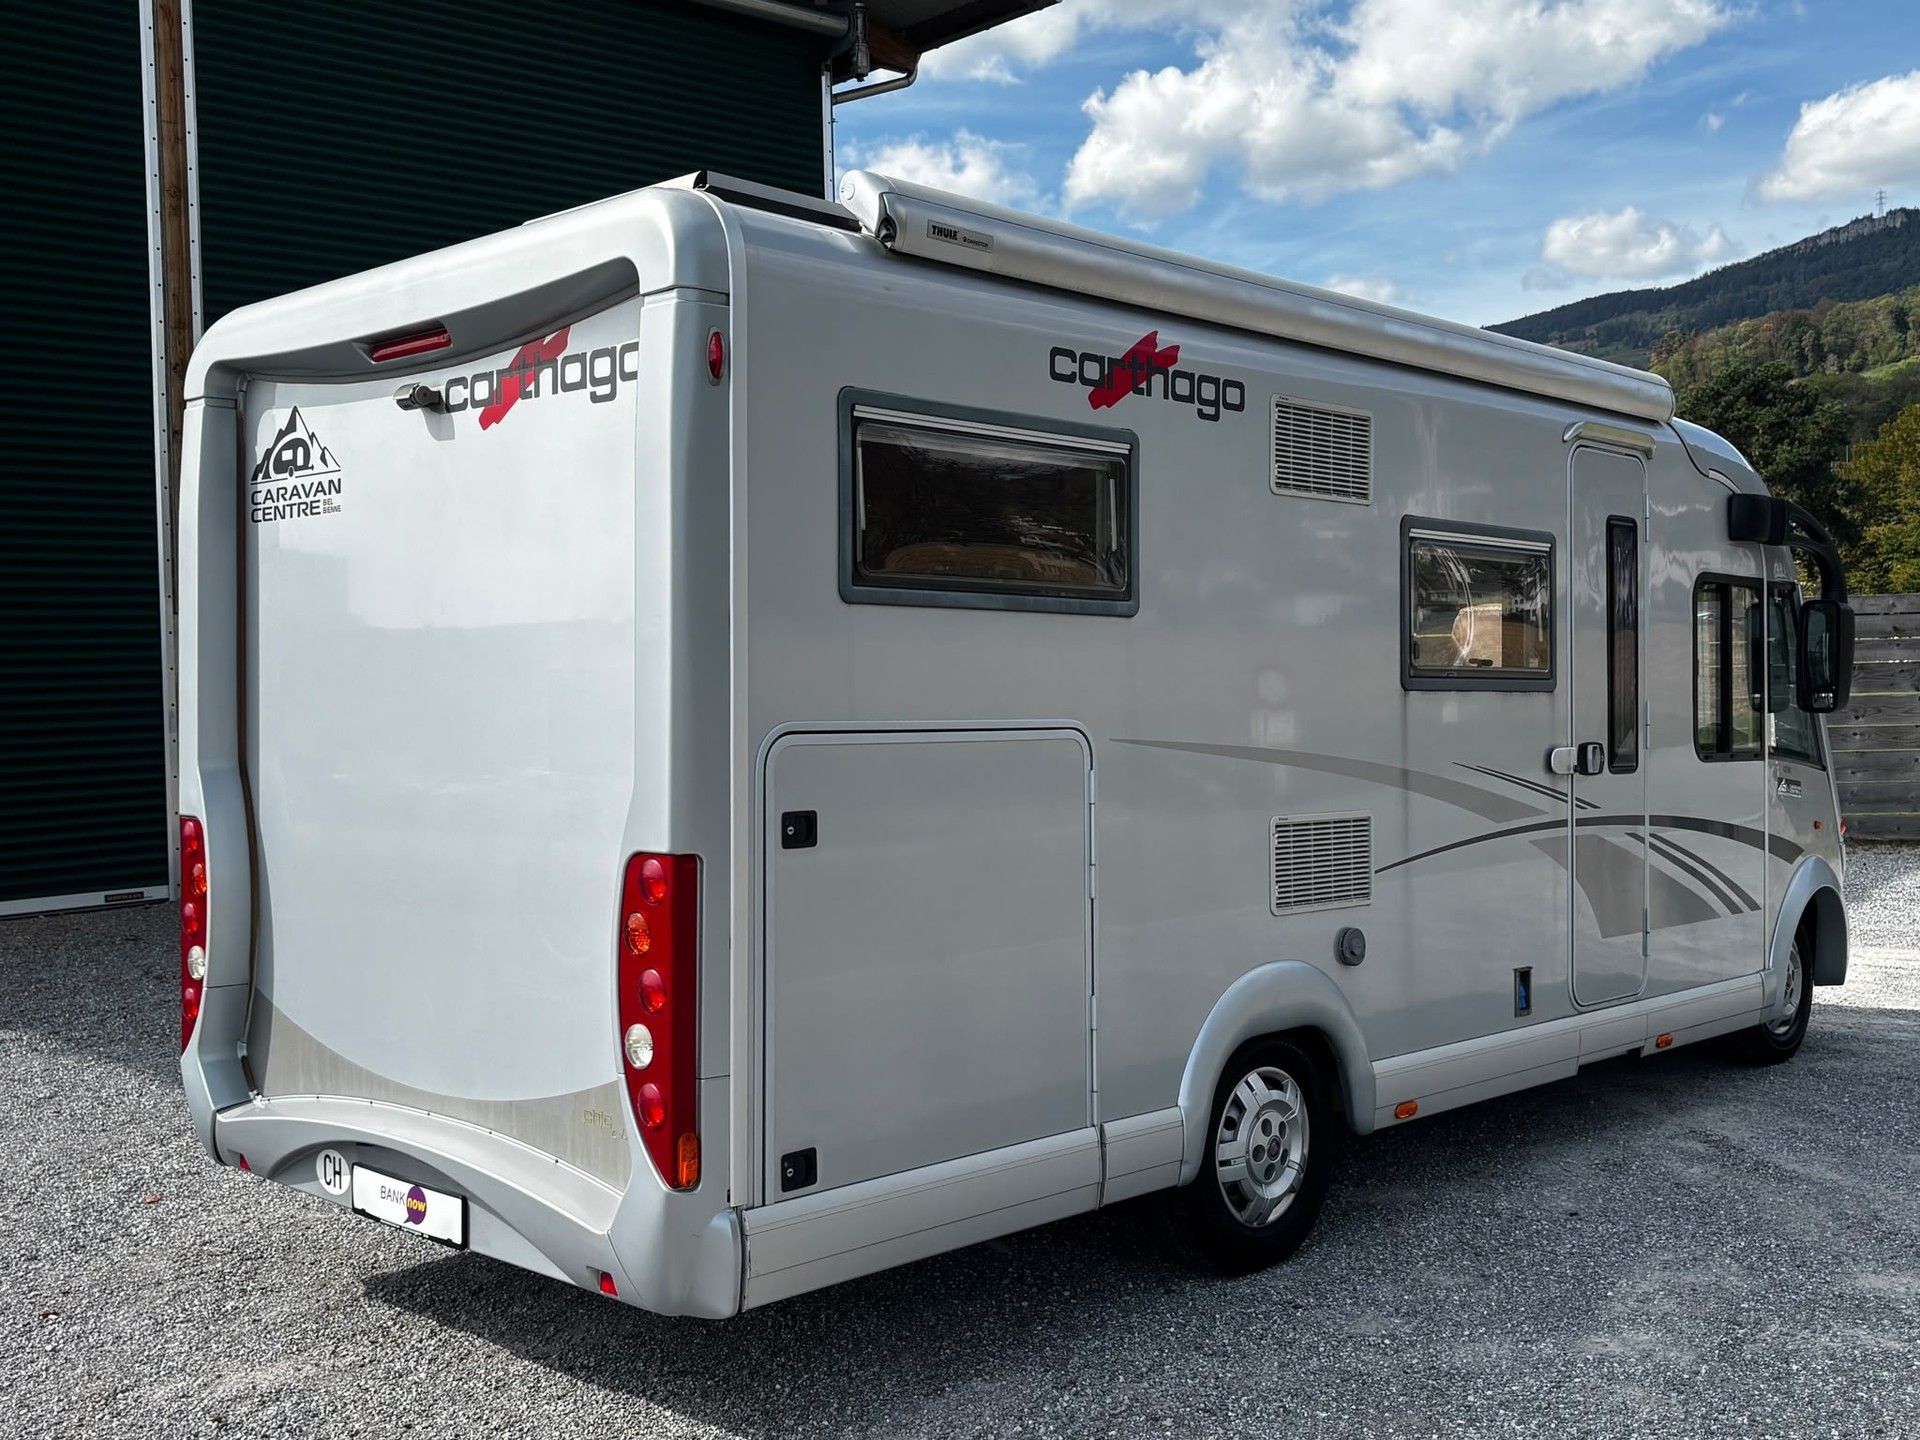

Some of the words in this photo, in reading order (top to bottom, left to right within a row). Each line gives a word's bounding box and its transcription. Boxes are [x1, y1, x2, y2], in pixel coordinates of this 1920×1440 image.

[931, 224, 959, 241] THULE
[1049, 346, 1246, 423] carthago
[250, 477, 342, 506] CARAVAN
[322, 497, 334, 507] BIEL
[250, 499, 322, 524] CENTRE
[322, 504, 342, 515] BIENNE
[323, 1153, 343, 1190] CH
[379, 1184, 406, 1207] BANK
[406, 1196, 427, 1213] now
